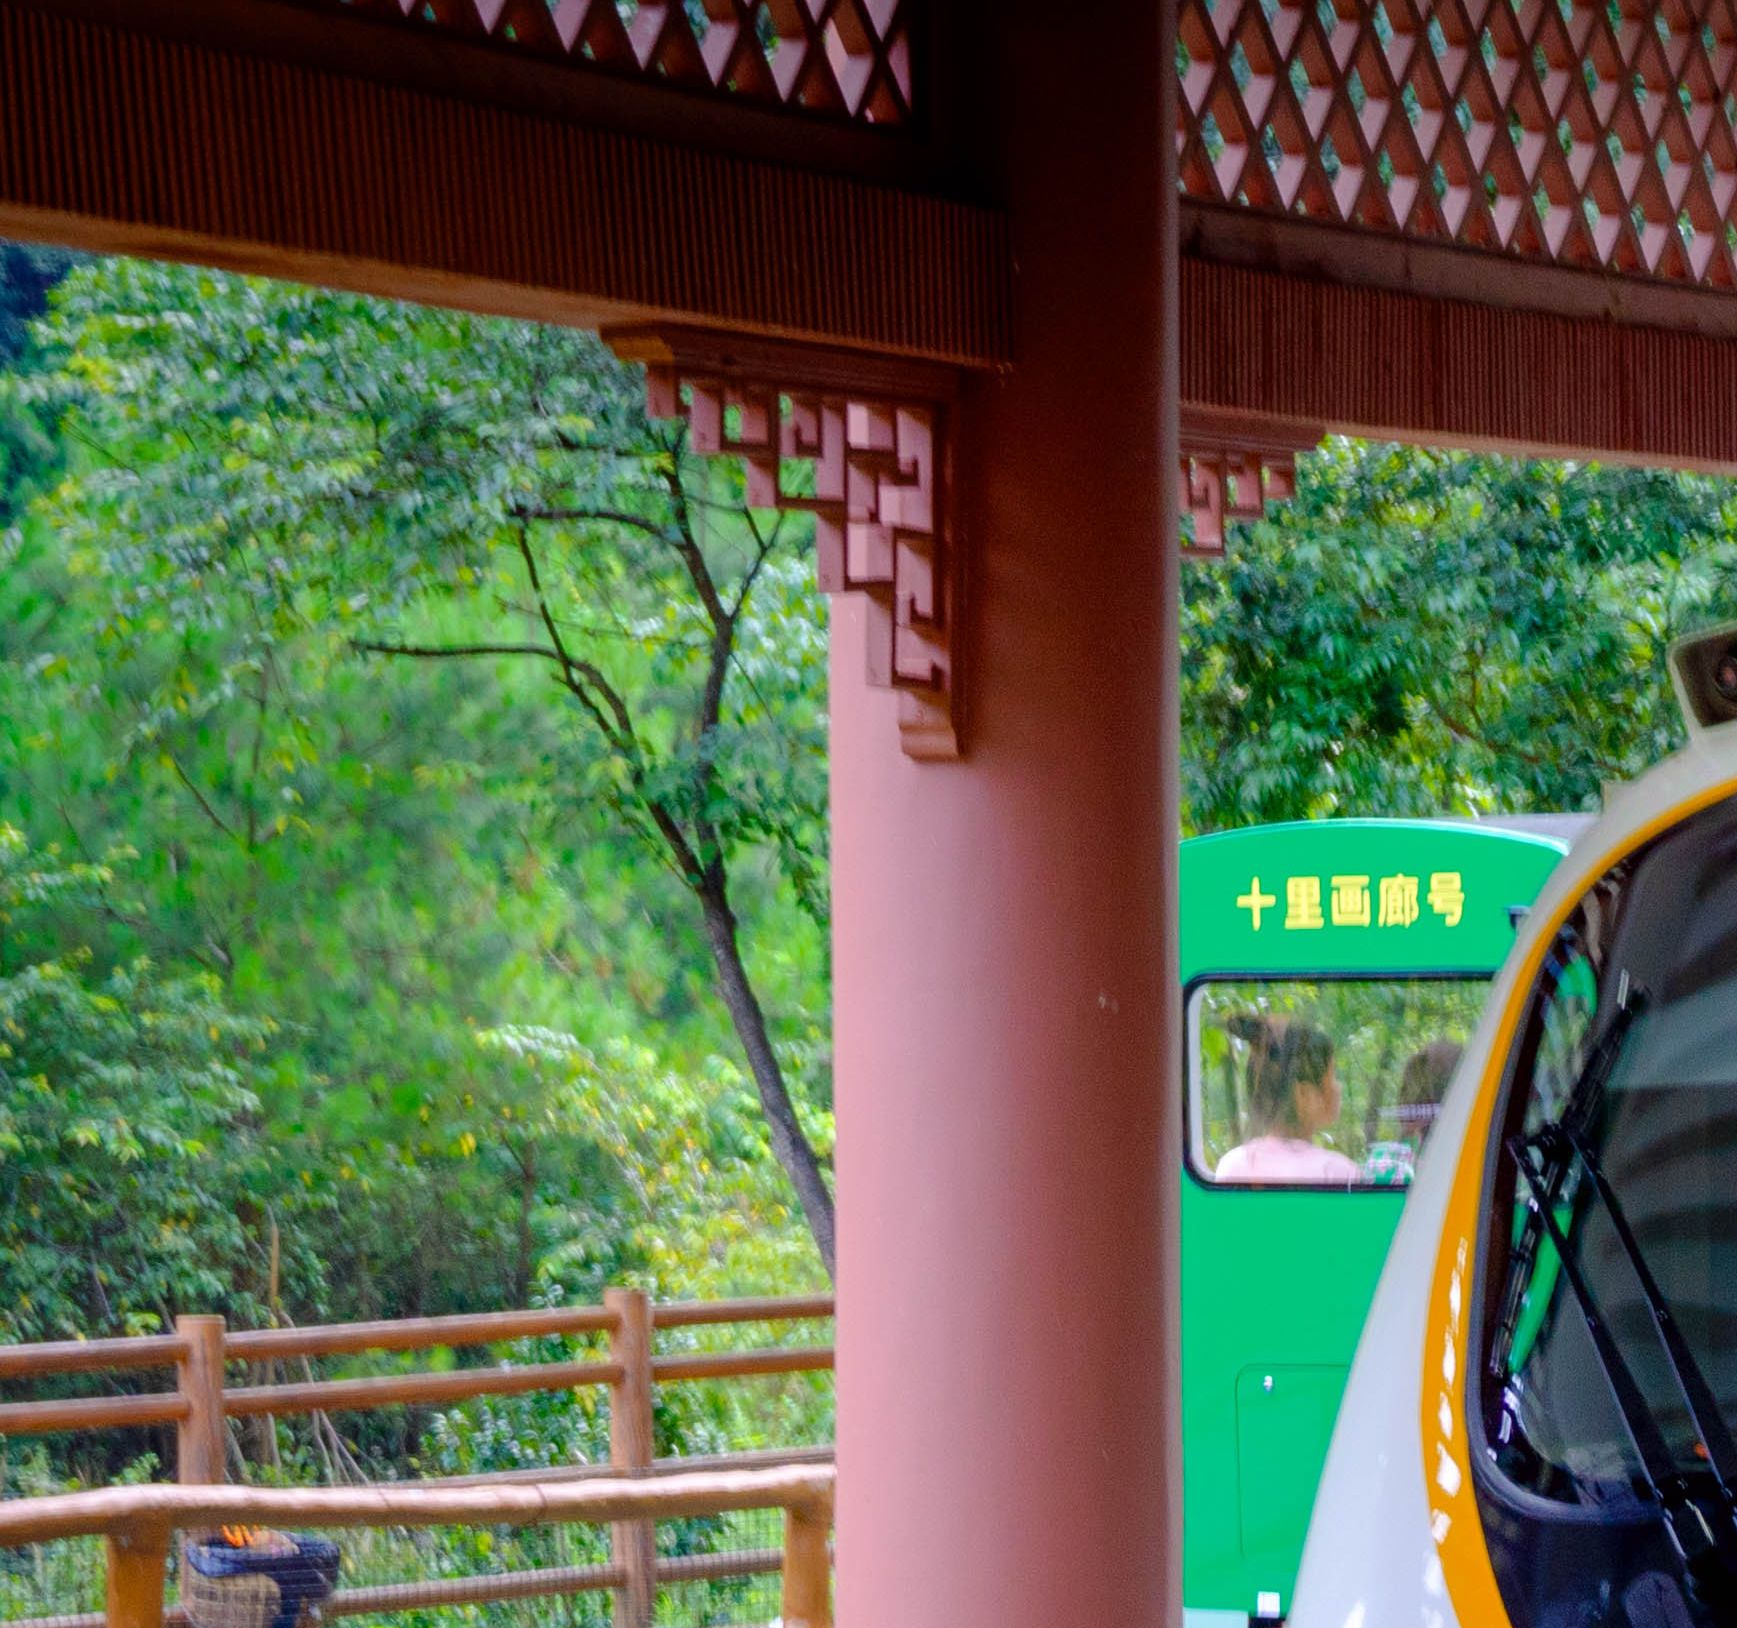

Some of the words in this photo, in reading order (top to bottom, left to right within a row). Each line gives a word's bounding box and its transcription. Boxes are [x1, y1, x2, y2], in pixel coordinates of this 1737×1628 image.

[1236, 872, 1465, 931] 十里画廊号
